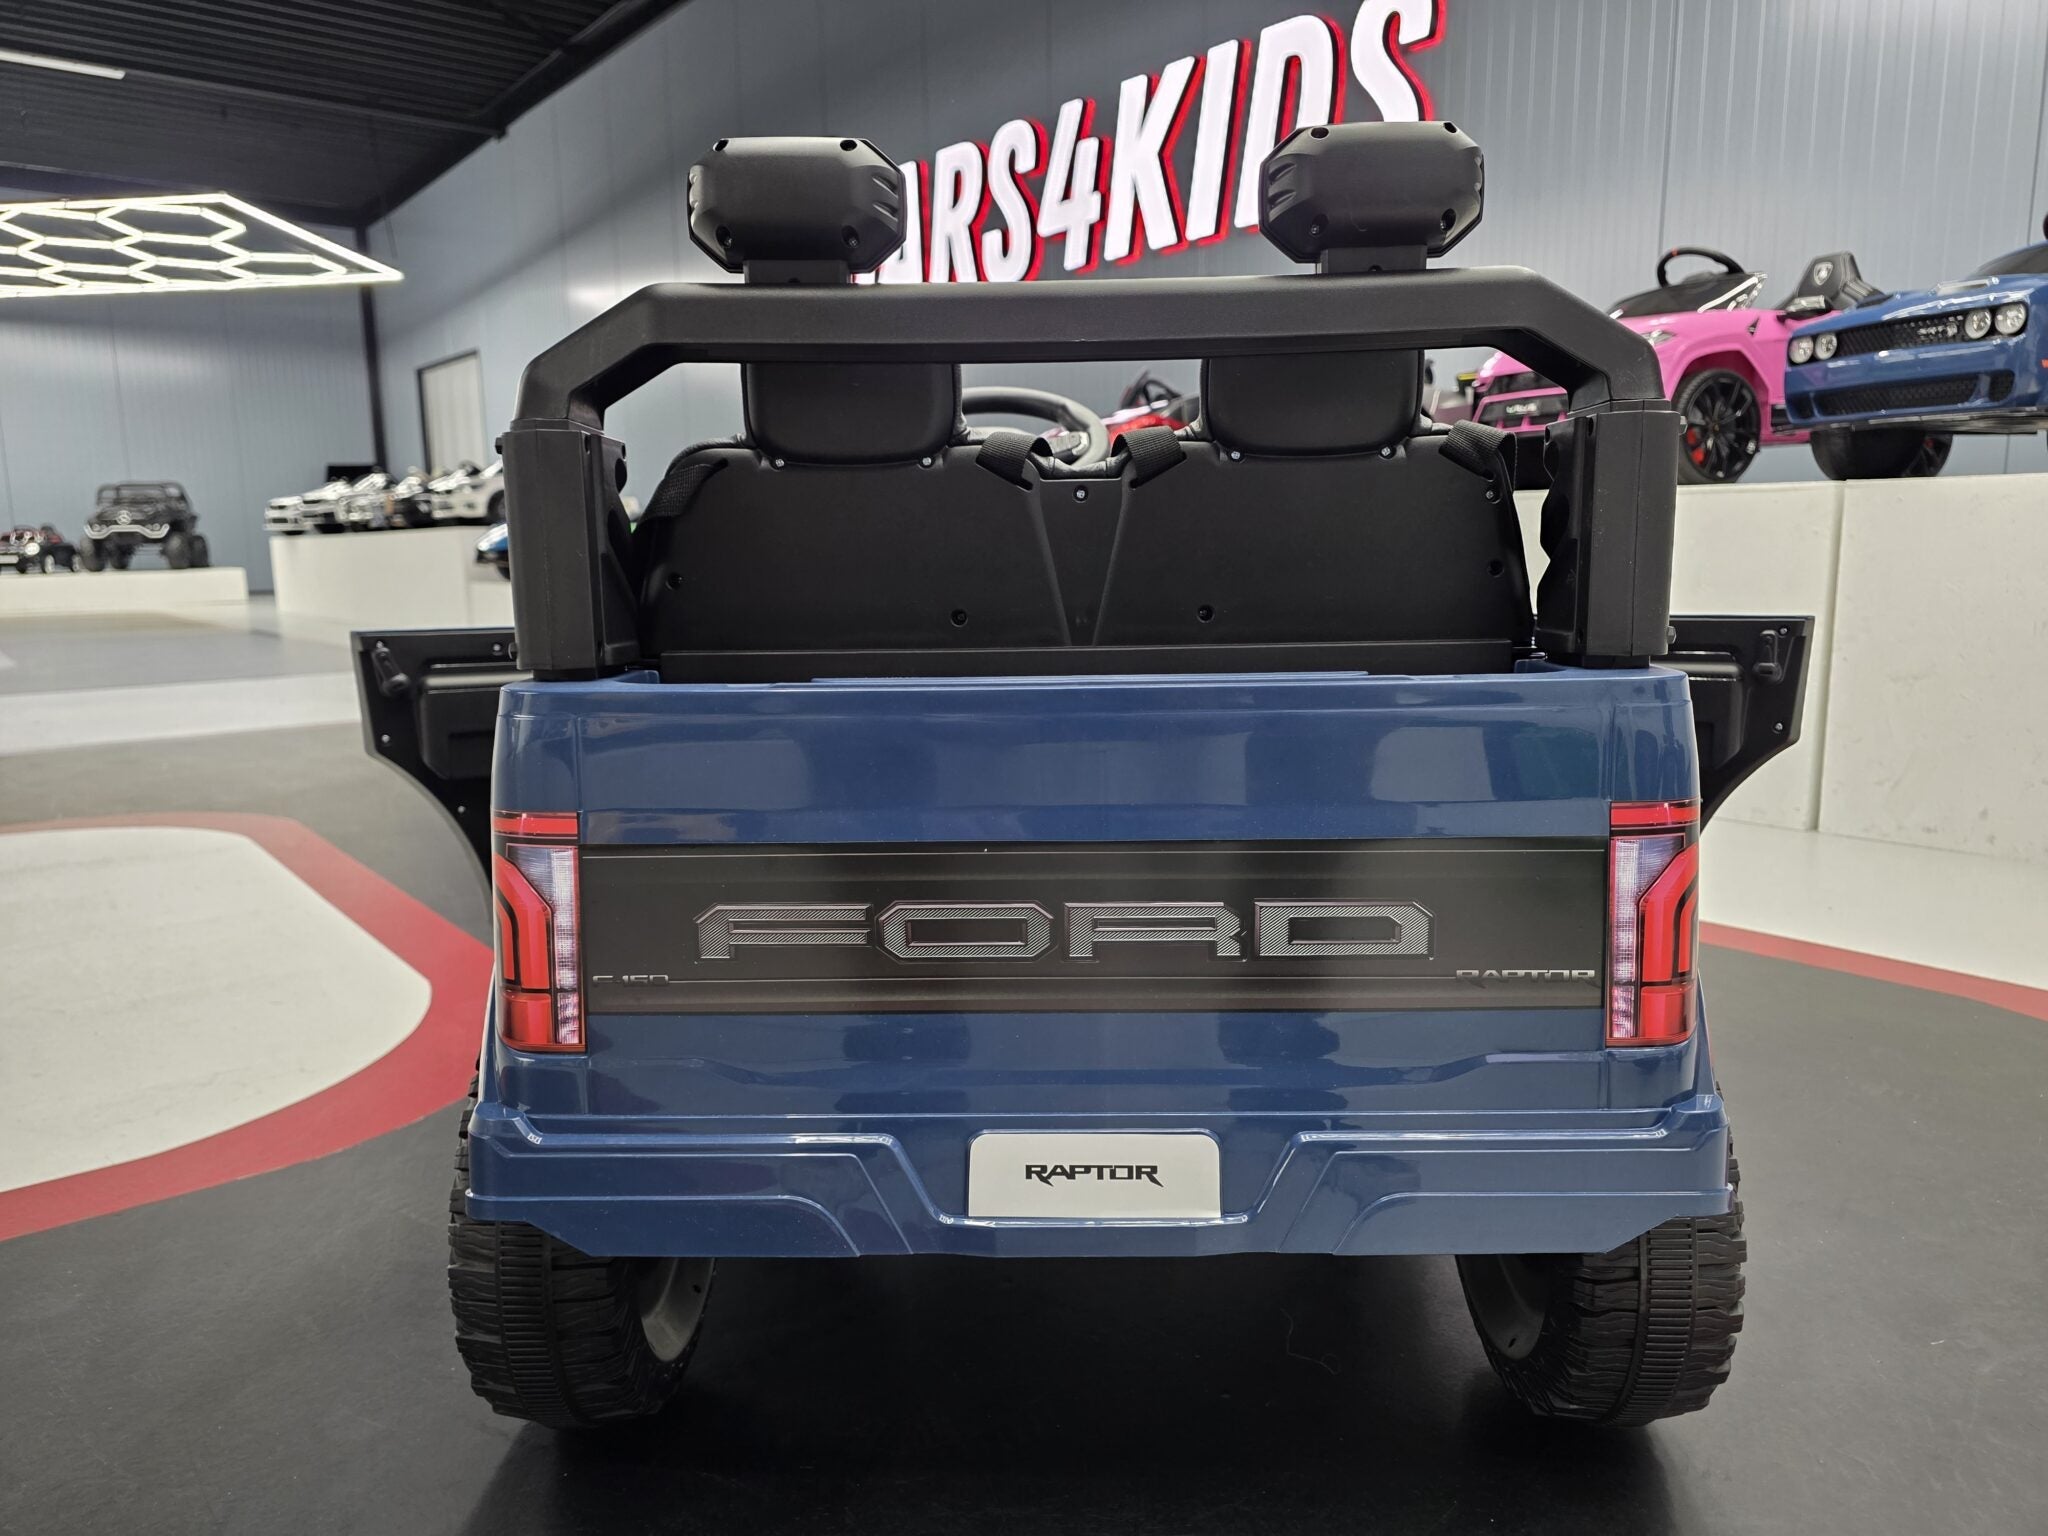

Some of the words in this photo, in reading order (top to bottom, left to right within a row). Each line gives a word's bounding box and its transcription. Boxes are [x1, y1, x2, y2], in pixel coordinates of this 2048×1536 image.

[860, 0, 1446, 284] ARS4KIDS
[695, 901, 1434, 961] FORD
[1456, 969, 1600, 988] RAPTOR
[1025, 1164, 1163, 1187] RAPTOR
